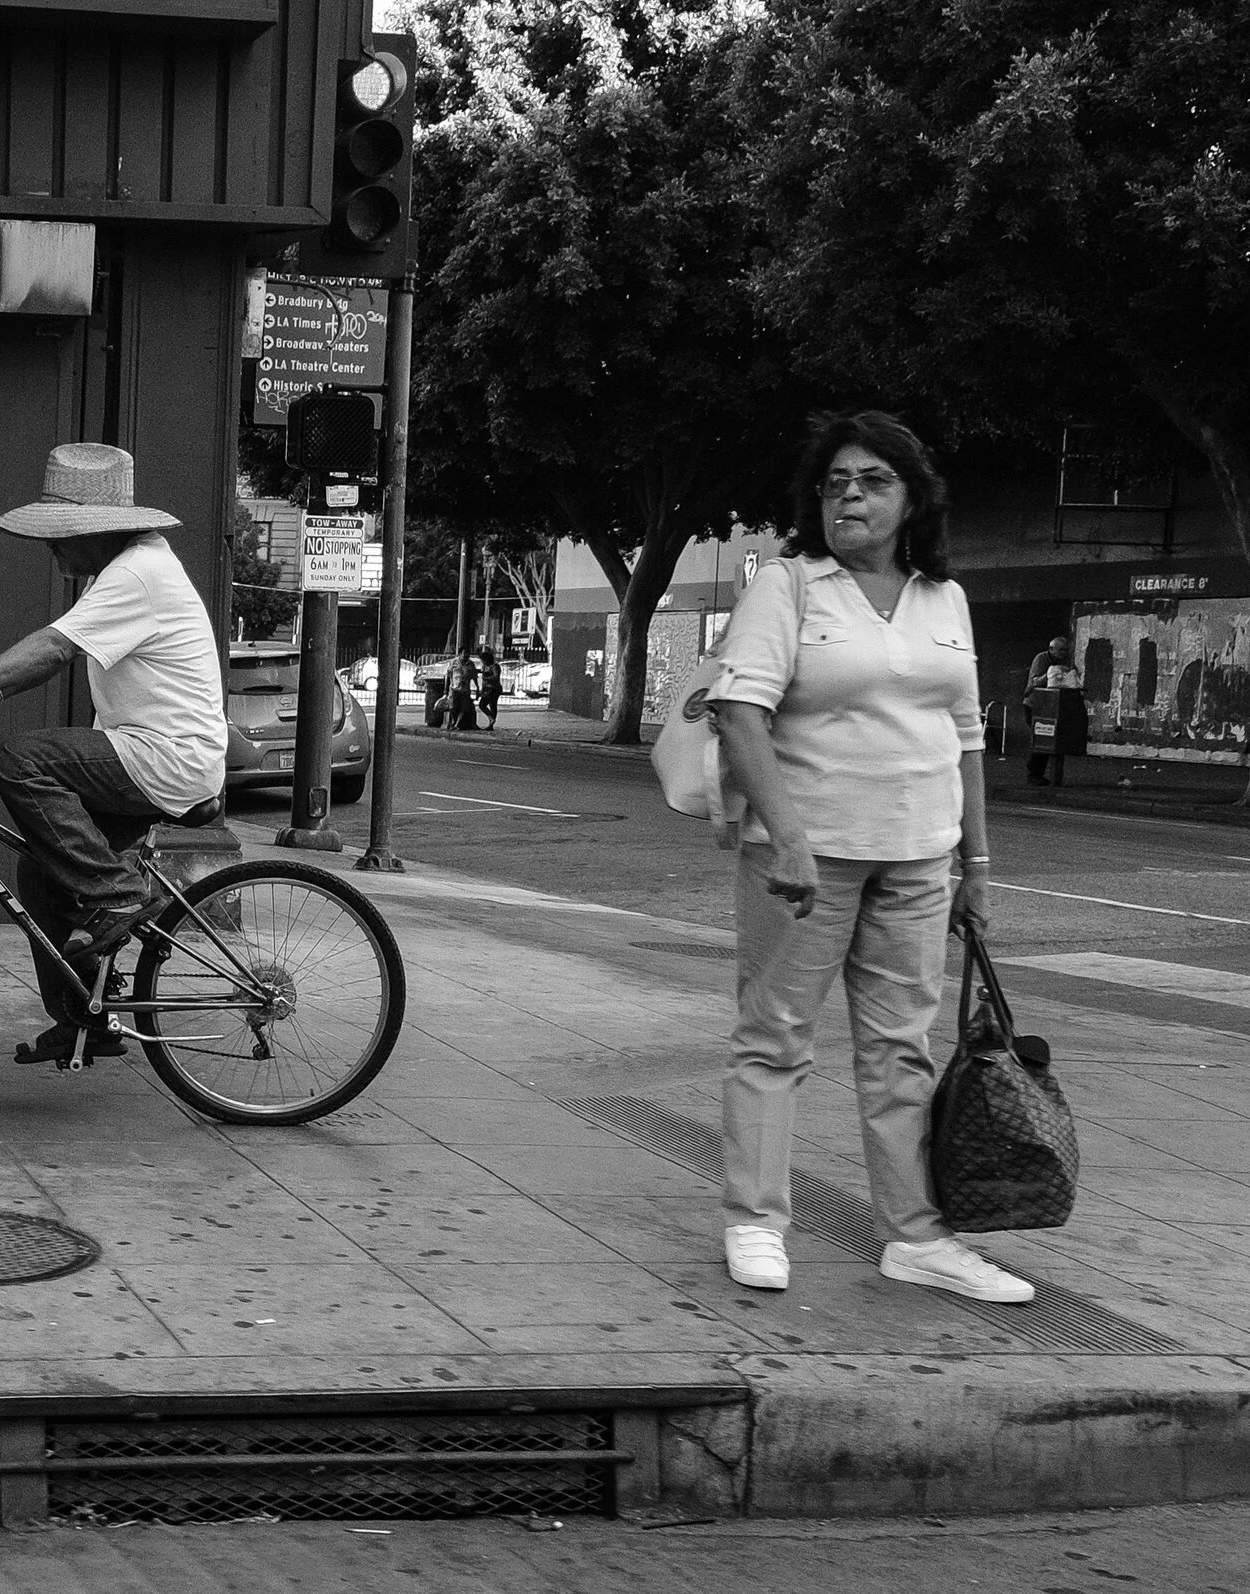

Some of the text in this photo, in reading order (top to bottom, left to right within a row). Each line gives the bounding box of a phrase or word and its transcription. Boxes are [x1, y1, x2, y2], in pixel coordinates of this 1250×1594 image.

[278, 295, 349, 313] Bradbury Bdg
[276, 316, 290, 327] LA
[292, 317, 322, 330] Times
[276, 337, 324, 350] Broadway
[274, 359, 366, 374] LA Theatre Center
[273, 380, 314, 392] Historic
[311, 518, 358, 528] TOW-AWAY
[306, 537, 361, 556] NO STOPPING
[310, 574, 337, 582] SUNDAY
[1135, 578, 1195, 591] CLEARANCE
